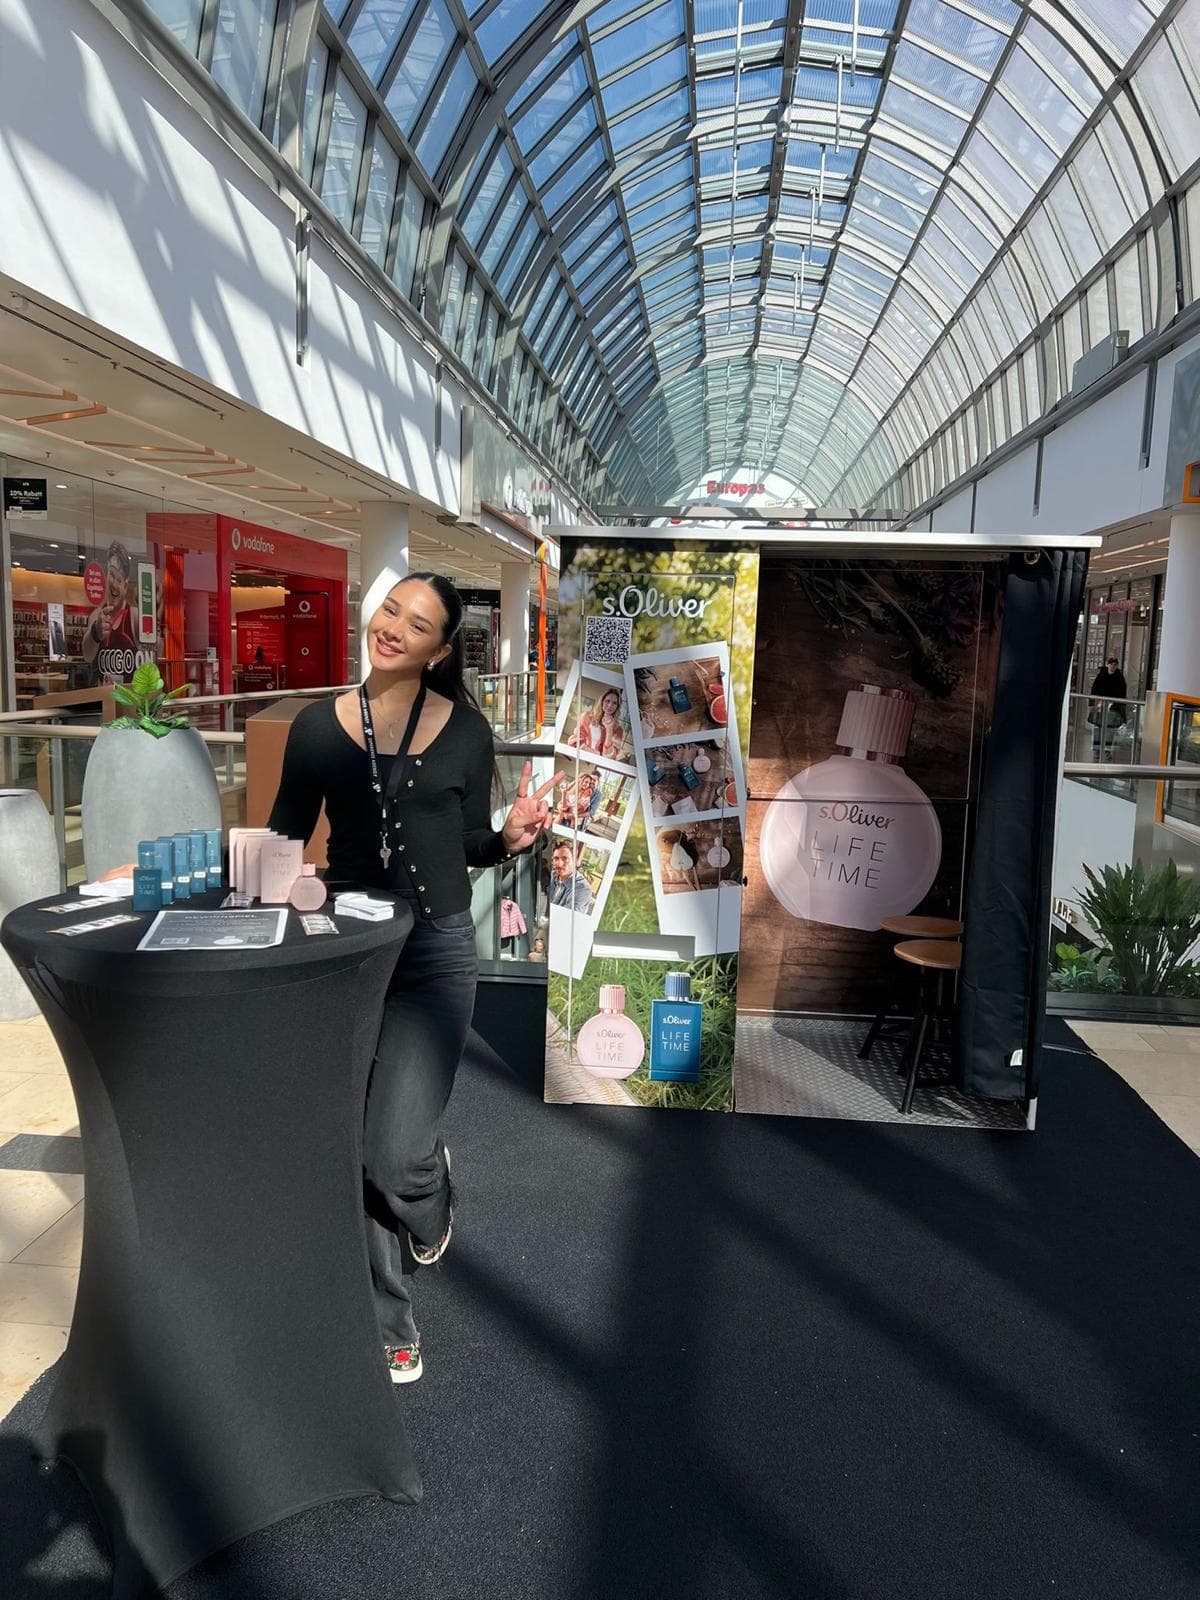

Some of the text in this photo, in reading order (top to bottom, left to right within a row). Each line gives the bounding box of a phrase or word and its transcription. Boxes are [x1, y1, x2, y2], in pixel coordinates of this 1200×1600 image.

[9, 489, 23, 497] 10%
[706, 480, 766, 497] Europas
[242, 536, 276, 555] vodafone
[602, 585, 713, 618] s.Oliver
[818, 801, 896, 830] s.Oliver
[811, 830, 887, 863] LIFE
[809, 856, 881, 890] TIME
[662, 1015, 692, 1025] s.Oliver
[661, 1031, 690, 1041] LIFE
[595, 1040, 625, 1051] LIFE
[662, 1041, 690, 1052] TIME
[596, 1052, 624, 1063] TIME
